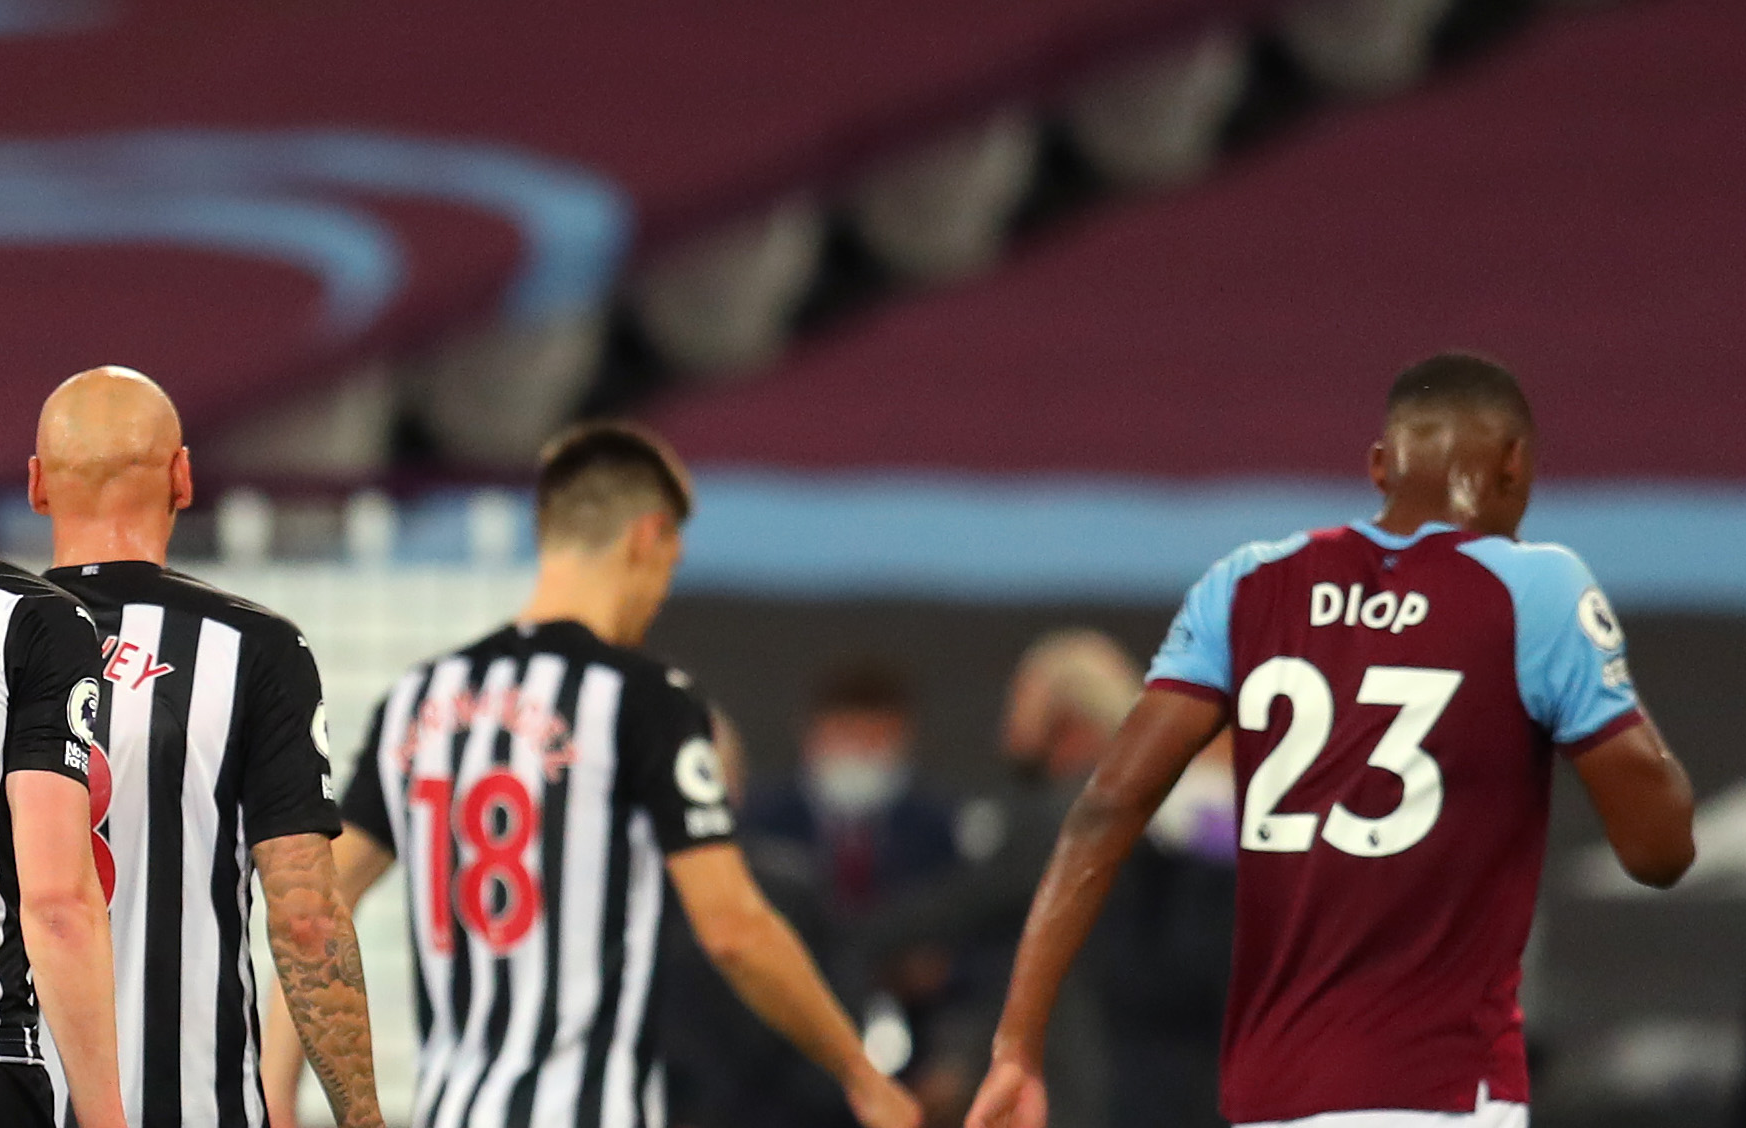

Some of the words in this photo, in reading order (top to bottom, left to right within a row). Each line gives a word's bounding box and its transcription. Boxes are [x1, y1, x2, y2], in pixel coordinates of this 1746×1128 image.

[102, 635, 176, 691] EY
[1308, 582, 1430, 635] DIOP
[1238, 656, 1465, 859] 23
[409, 765, 543, 957] 18
